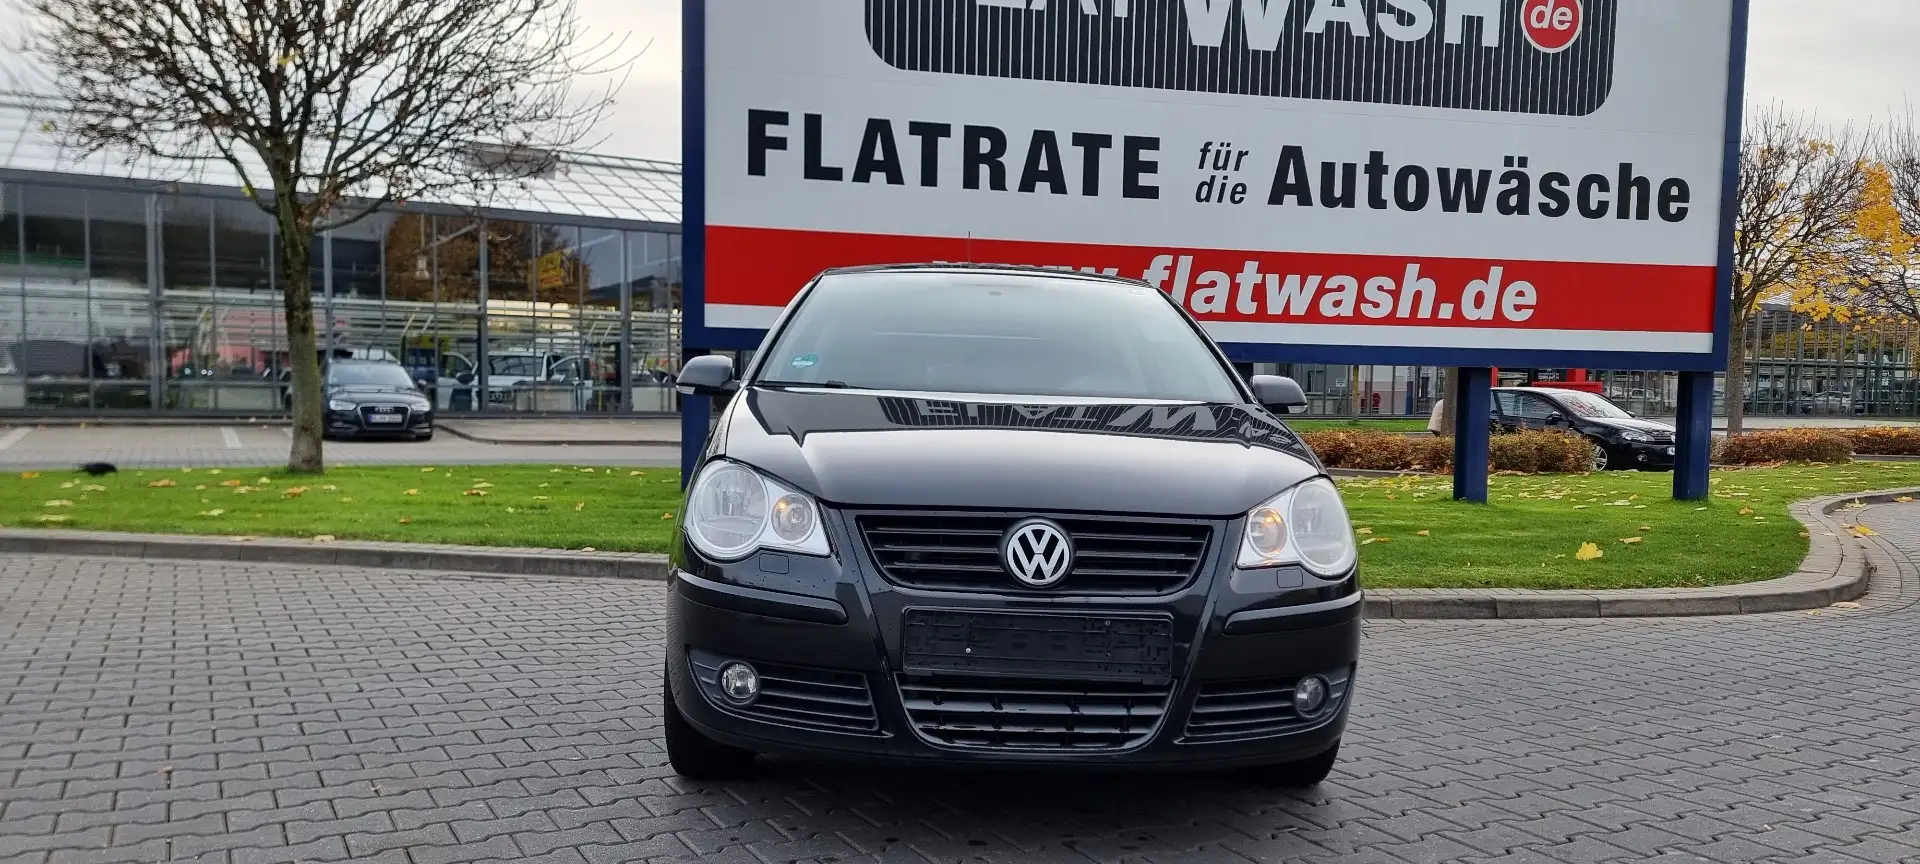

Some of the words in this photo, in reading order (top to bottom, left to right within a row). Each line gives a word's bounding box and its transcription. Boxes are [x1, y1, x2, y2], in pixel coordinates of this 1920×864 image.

[1530, 0, 1573, 31] de
[747, 109, 1161, 200] FLATRATE
[1198, 141, 1250, 172] für
[1195, 174, 1247, 205] die
[1267, 145, 1691, 223] Autowäsche
[1007, 524, 1070, 586] VW
